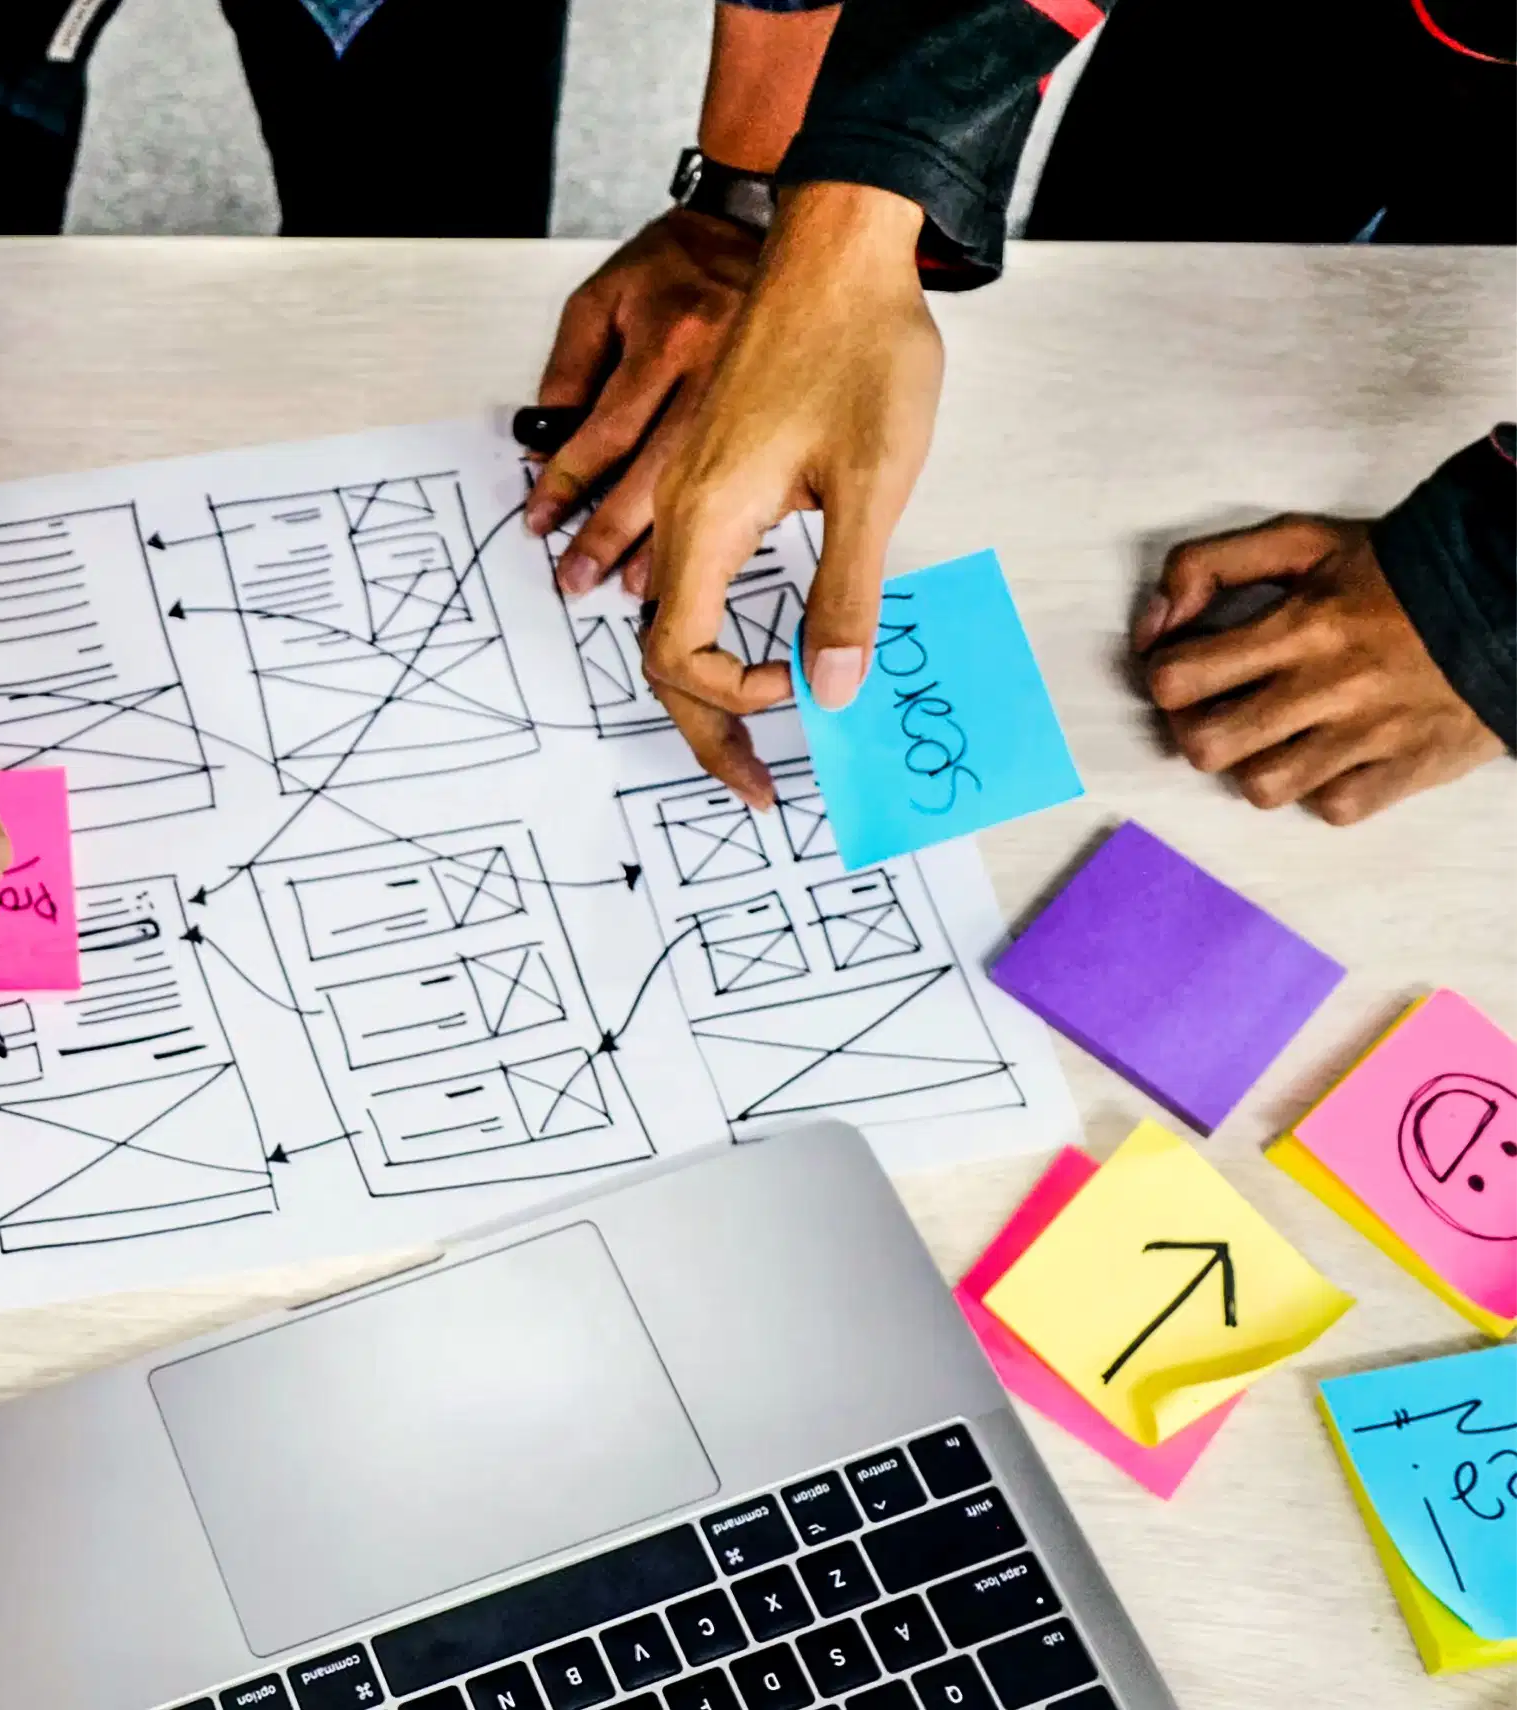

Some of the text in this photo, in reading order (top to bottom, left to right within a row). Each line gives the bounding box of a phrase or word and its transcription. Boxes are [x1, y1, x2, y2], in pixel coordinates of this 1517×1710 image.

[857, 1458, 898, 1482] control
[792, 1483, 830, 1504] option
[965, 1499, 993, 1518] shift
[711, 1505, 770, 1536] command
[828, 1569, 847, 1588] Z
[974, 1564, 1028, 1592] caps lock
[764, 1593, 783, 1613] X
[697, 1617, 715, 1636] C
[894, 1622, 911, 1641] A
[1043, 1631, 1065, 1646] tab
[634, 1643, 651, 1662] V
[829, 1648, 846, 1667] S
[300, 1654, 361, 1684] command
[565, 1666, 583, 1686] B
[763, 1672, 781, 1691] D
[236, 1684, 277, 1707] option
[497, 1690, 516, 1710] N
[944, 1685, 963, 1704] Q
